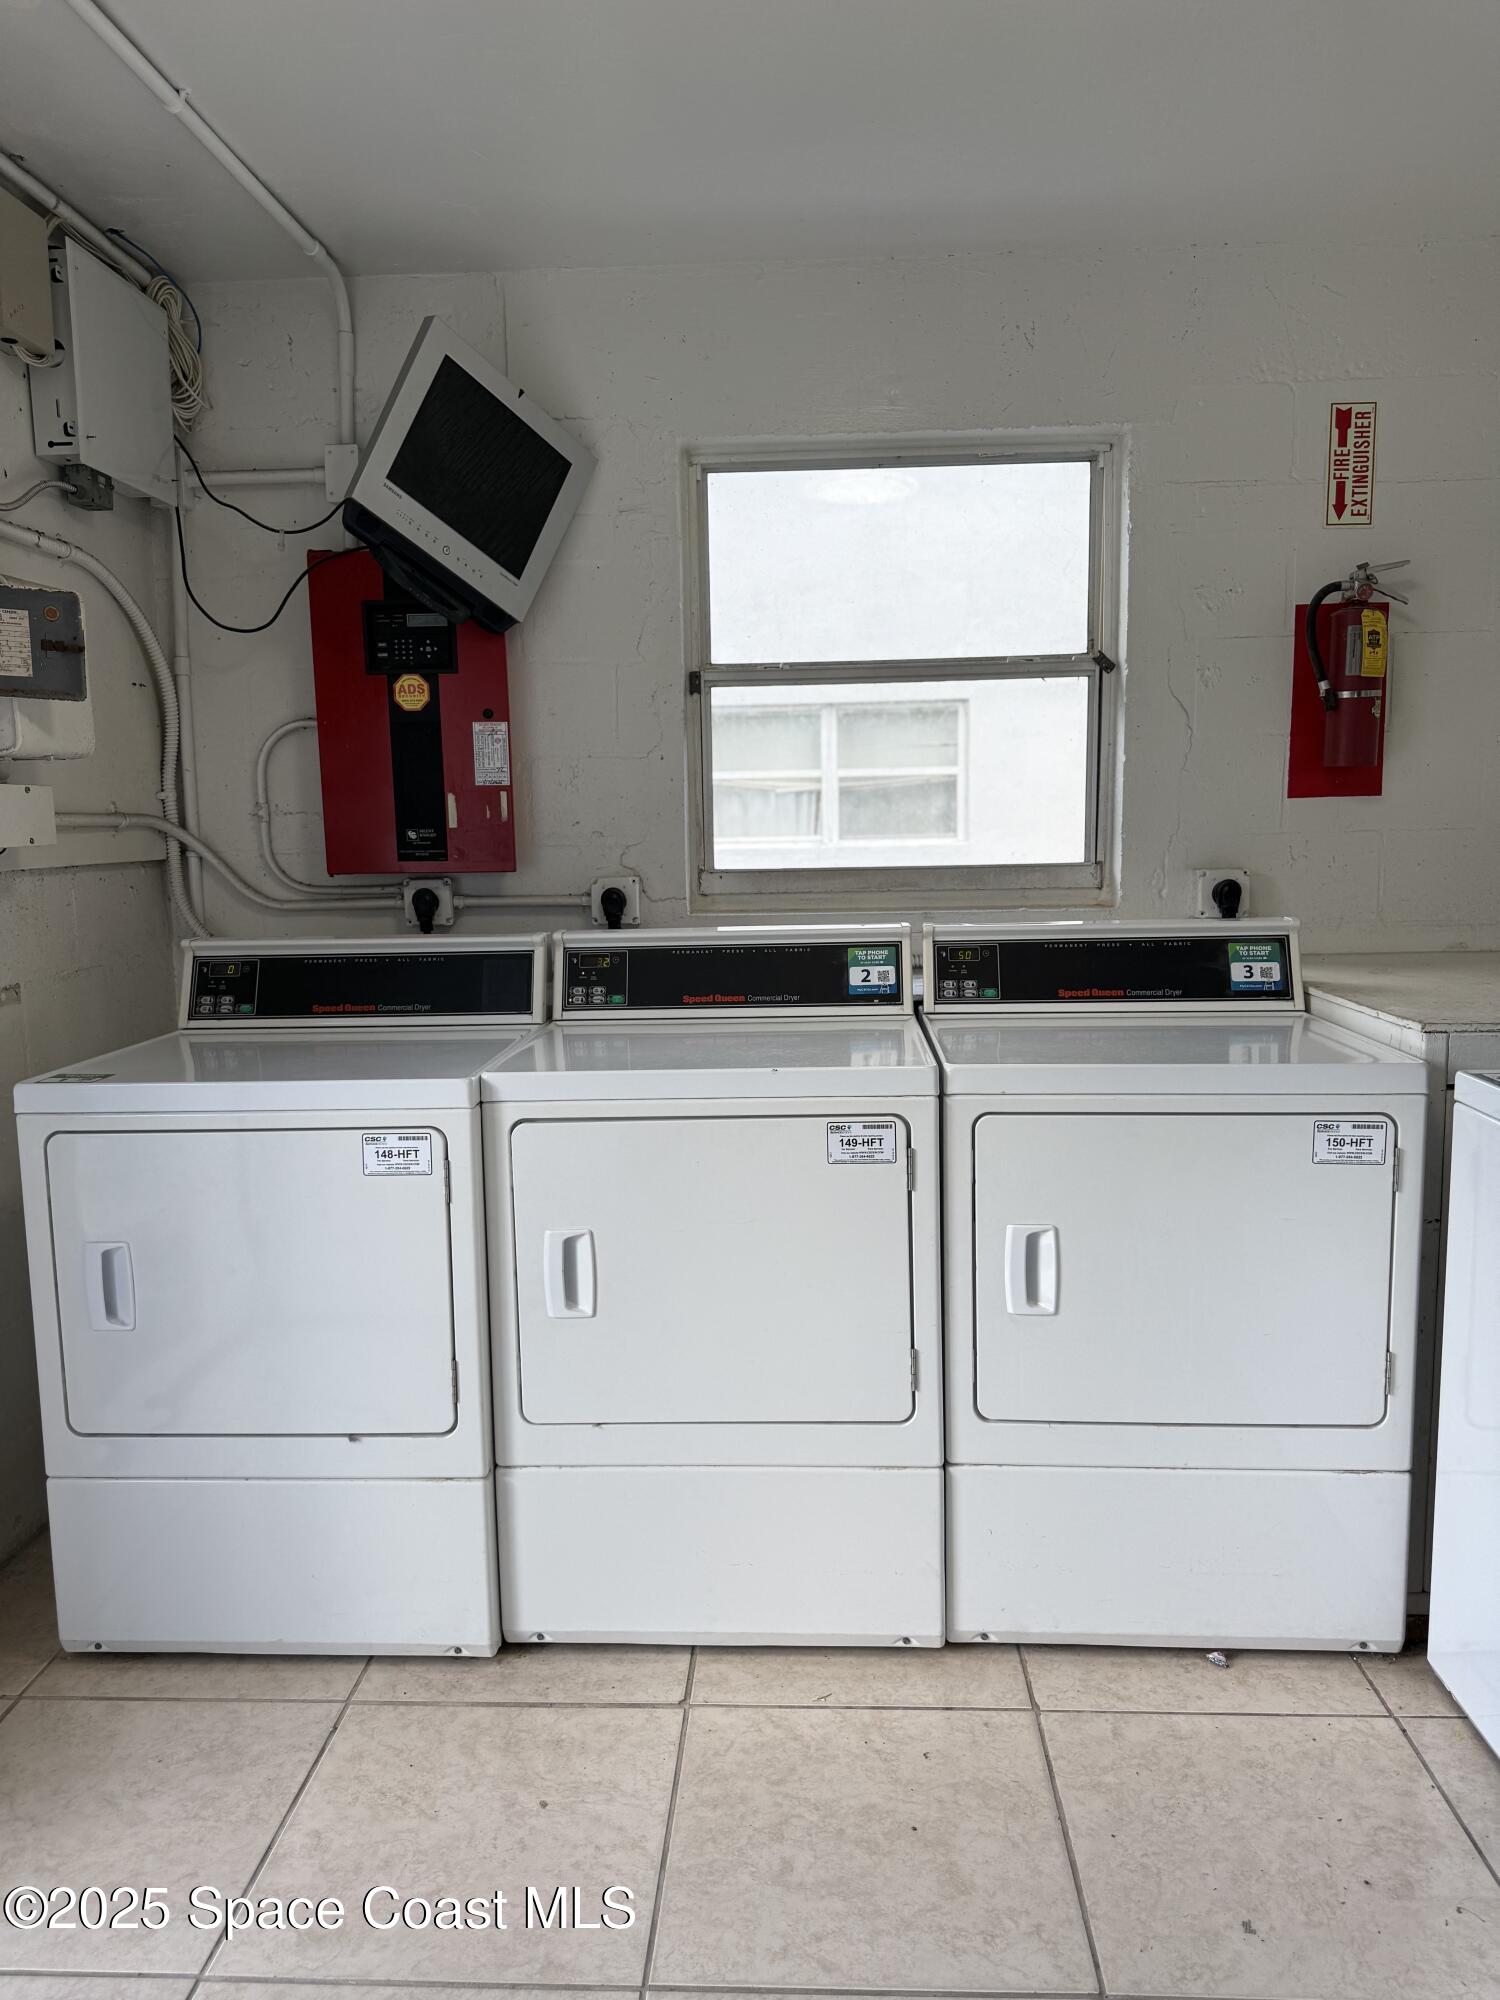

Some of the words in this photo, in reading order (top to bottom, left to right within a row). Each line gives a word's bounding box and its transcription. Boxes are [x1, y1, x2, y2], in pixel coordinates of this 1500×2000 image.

[1334, 448, 1350, 480] FIRE
[1351, 410, 1372, 517] EXTINGUISHER
[398, 683, 426, 694] ADS
[958, 951, 971, 960] 50
[228, 965, 234, 973] 0
[1244, 965, 1254, 979] 3
[861, 969, 871, 982] 2
[1058, 989, 1090, 998] Speed
[1092, 988, 1124, 996] Queen
[1164, 989, 1182, 997] Dryer
[682, 995, 713, 1004] Speed
[312, 1004, 343, 1013] Speed
[414, 1003, 430, 1012] Dryer
[839, 1138, 884, 1147] 149-HFT
[1326, 1138, 1374, 1147] 150-HFT
[375, 1150, 420, 1159] 148-HFT
